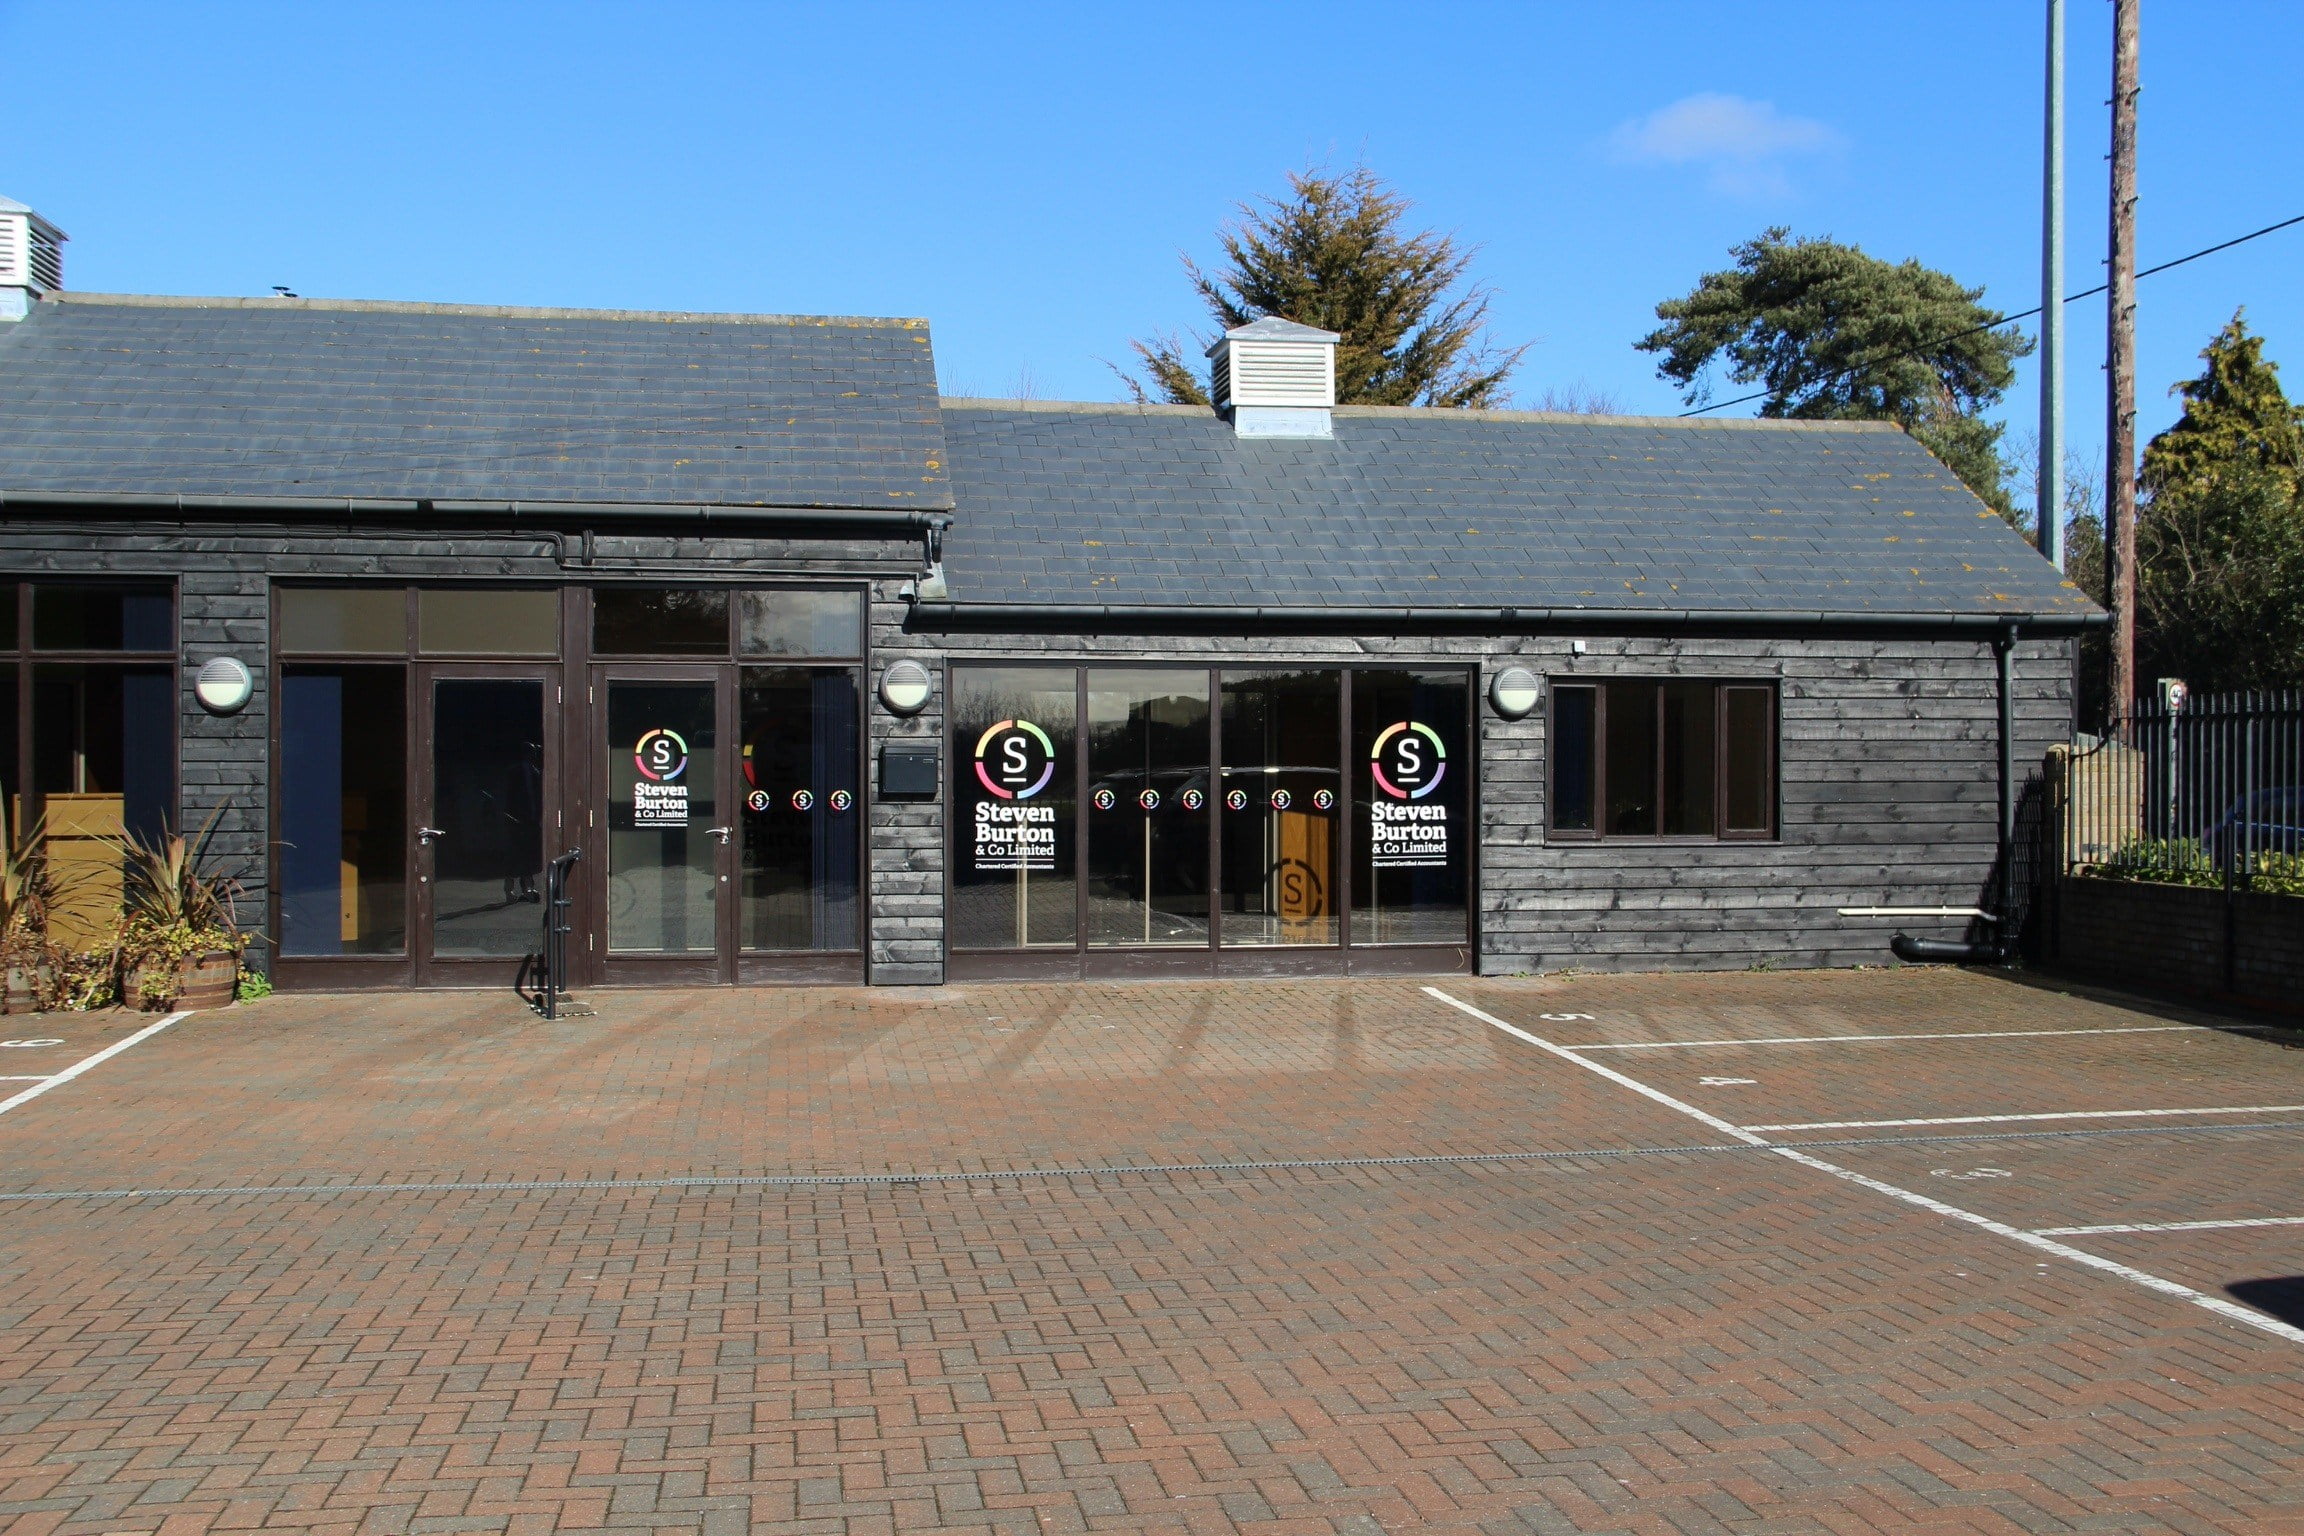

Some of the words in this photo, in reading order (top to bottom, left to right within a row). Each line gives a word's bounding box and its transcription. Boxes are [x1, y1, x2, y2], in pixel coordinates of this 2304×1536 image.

[653, 739, 670, 764] S
[1002, 736, 1027, 773] S
[1397, 738, 1421, 774] S
[635, 782, 688, 796] Steven
[635, 797, 688, 809] Burton
[635, 810, 641, 818] &
[643, 810, 654, 818] Co
[656, 810, 688, 818] Limited
[975, 802, 1055, 822] Steven
[1371, 801, 1446, 821] Steven
[975, 823, 1055, 842] Burton
[1371, 822, 1447, 841] Burton
[975, 844, 985, 856] &
[988, 844, 1004, 856] Co
[1007, 844, 1055, 856] Limited
[1372, 843, 1381, 854] &
[1384, 843, 1399, 854] Co
[1402, 841, 1447, 853] Limited
[1540, 1013, 1596, 1021] 5
[1700, 1076, 1758, 1086] 4
[1930, 1167, 2013, 1180] 3
